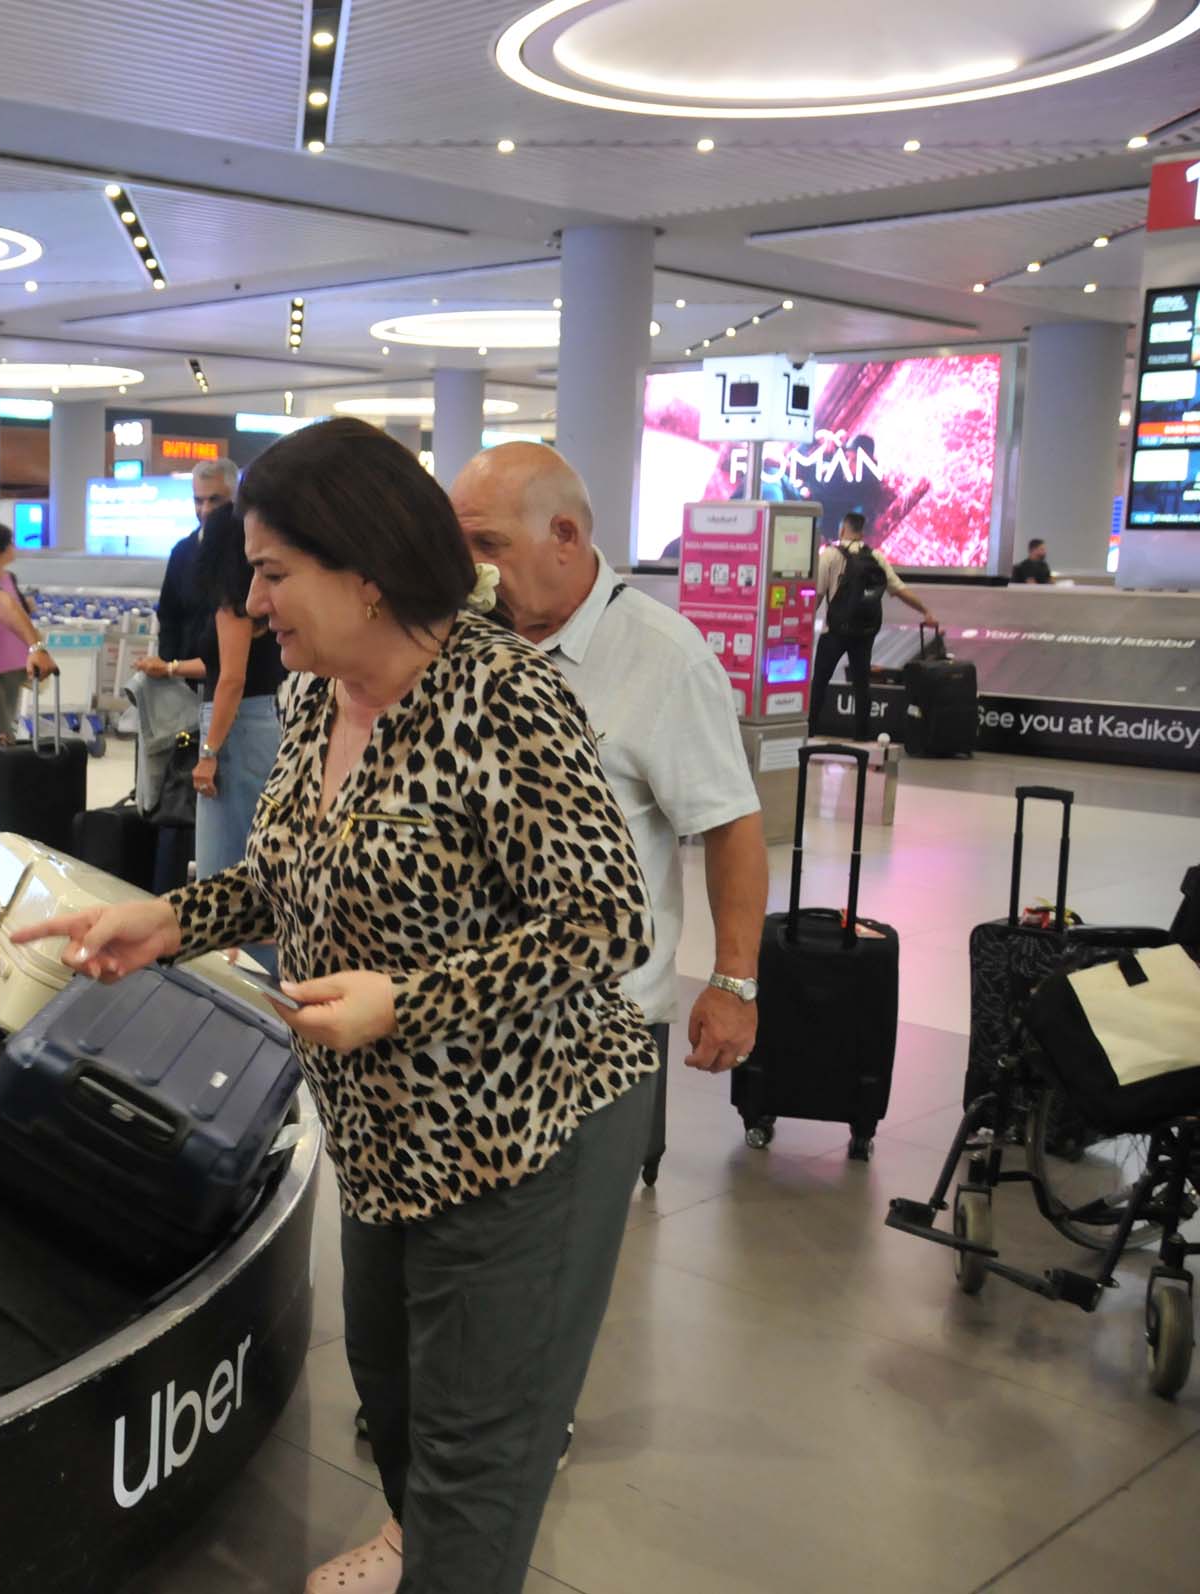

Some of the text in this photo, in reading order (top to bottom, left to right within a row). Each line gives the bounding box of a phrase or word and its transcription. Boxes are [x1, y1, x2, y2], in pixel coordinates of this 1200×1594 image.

[163, 440, 191, 458] DUTY
[985, 629, 1019, 640] Your
[1021, 631, 1055, 641] ride
[1056, 634, 1121, 646] around
[1019, 713, 1064, 736] you
[1068, 716, 1093, 736] at
[1098, 714, 1200, 749] Kadıköy
[113, 1334, 252, 1508] Uber
